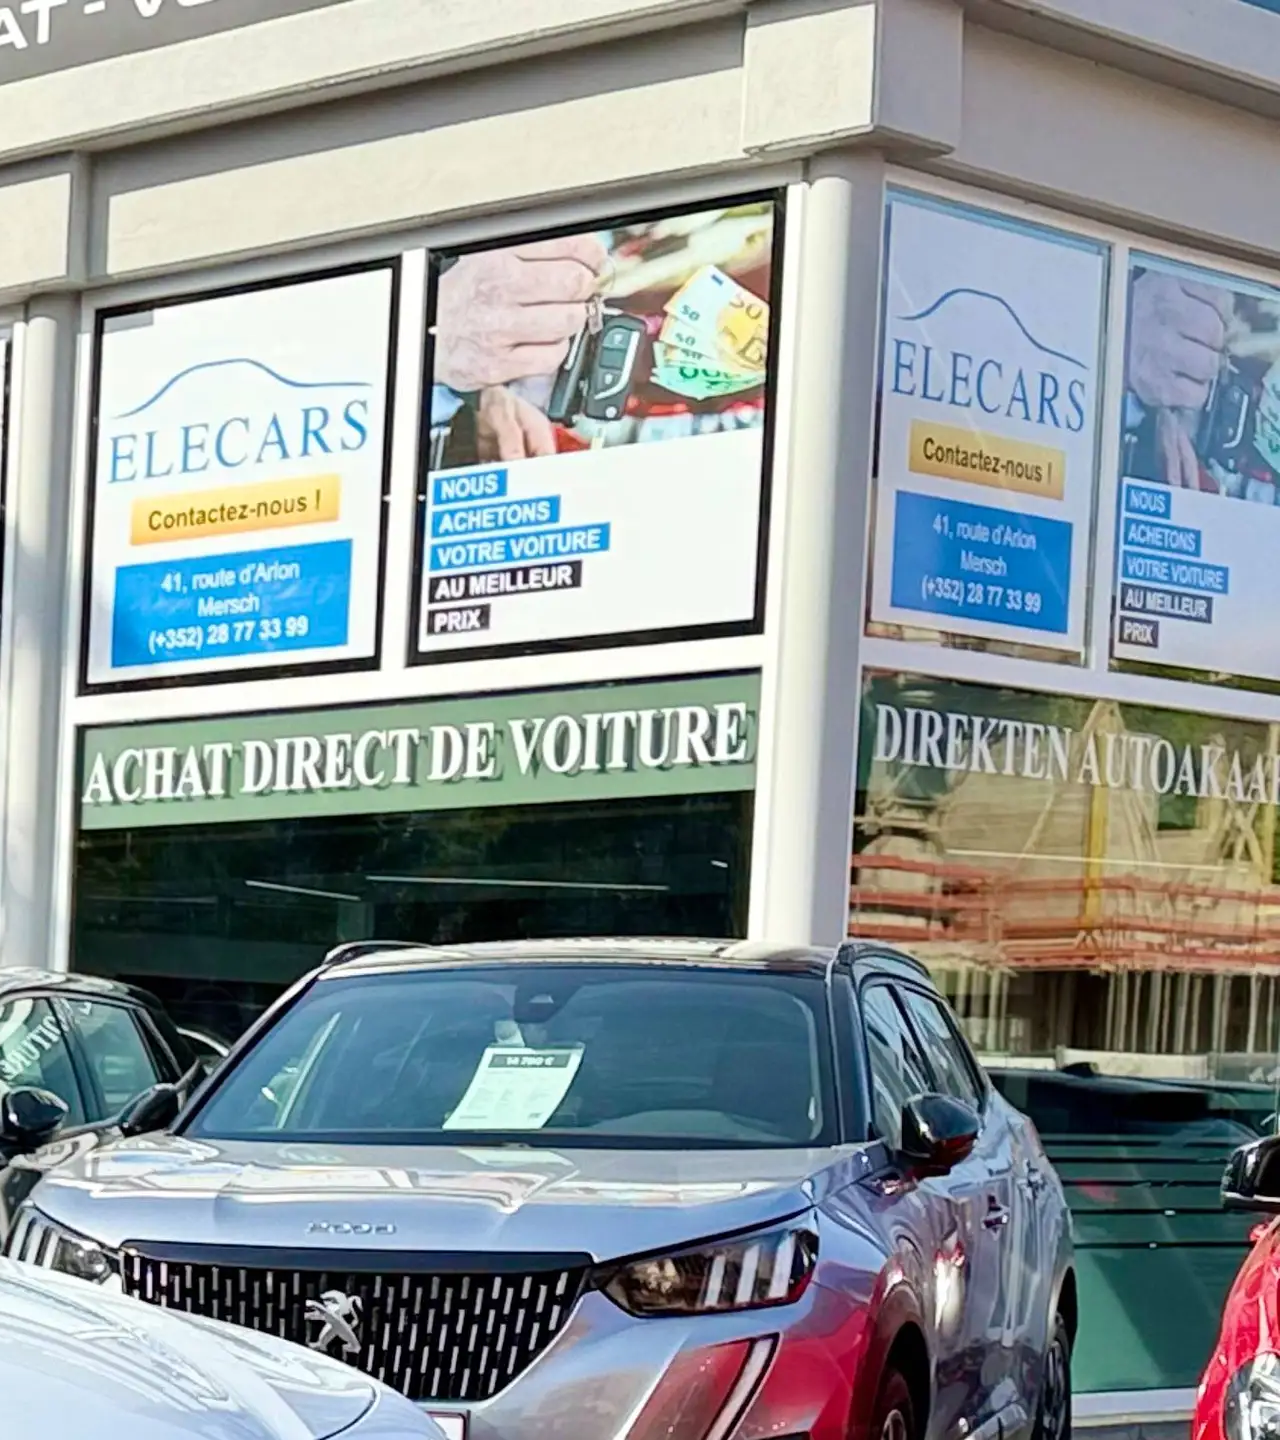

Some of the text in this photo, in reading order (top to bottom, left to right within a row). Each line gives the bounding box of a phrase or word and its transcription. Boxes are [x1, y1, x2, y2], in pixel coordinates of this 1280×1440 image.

[891, 338, 1086, 433] ELECARS
[107, 399, 368, 484] ELECARS
[922, 437, 1044, 484] Contactez-nous
[440, 474, 499, 499] NOUS
[1129, 489, 1166, 514] NOUS
[148, 494, 308, 531] Contactez-nous
[439, 501, 551, 533] ACHETONS
[438, 529, 601, 567] VOTRE VOITURE
[1127, 525, 1197, 553] ACHETONS
[192, 568, 236, 591] route
[435, 565, 573, 599] AU MEILLEUR
[1127, 555, 1225, 590] VOTRE VOITURE
[197, 594, 260, 618] Mersch
[966, 581, 984, 605] 28
[987, 585, 1003, 607] 77
[1125, 589, 1208, 618] AU MEILLEUR
[148, 615, 309, 654] (+352) 28 77 33 99
[433, 609, 482, 633] PRIX
[81, 702, 748, 804] ACHAT DIRECT DE VOITURE
[873, 704, 1072, 782] DIREKTEN
